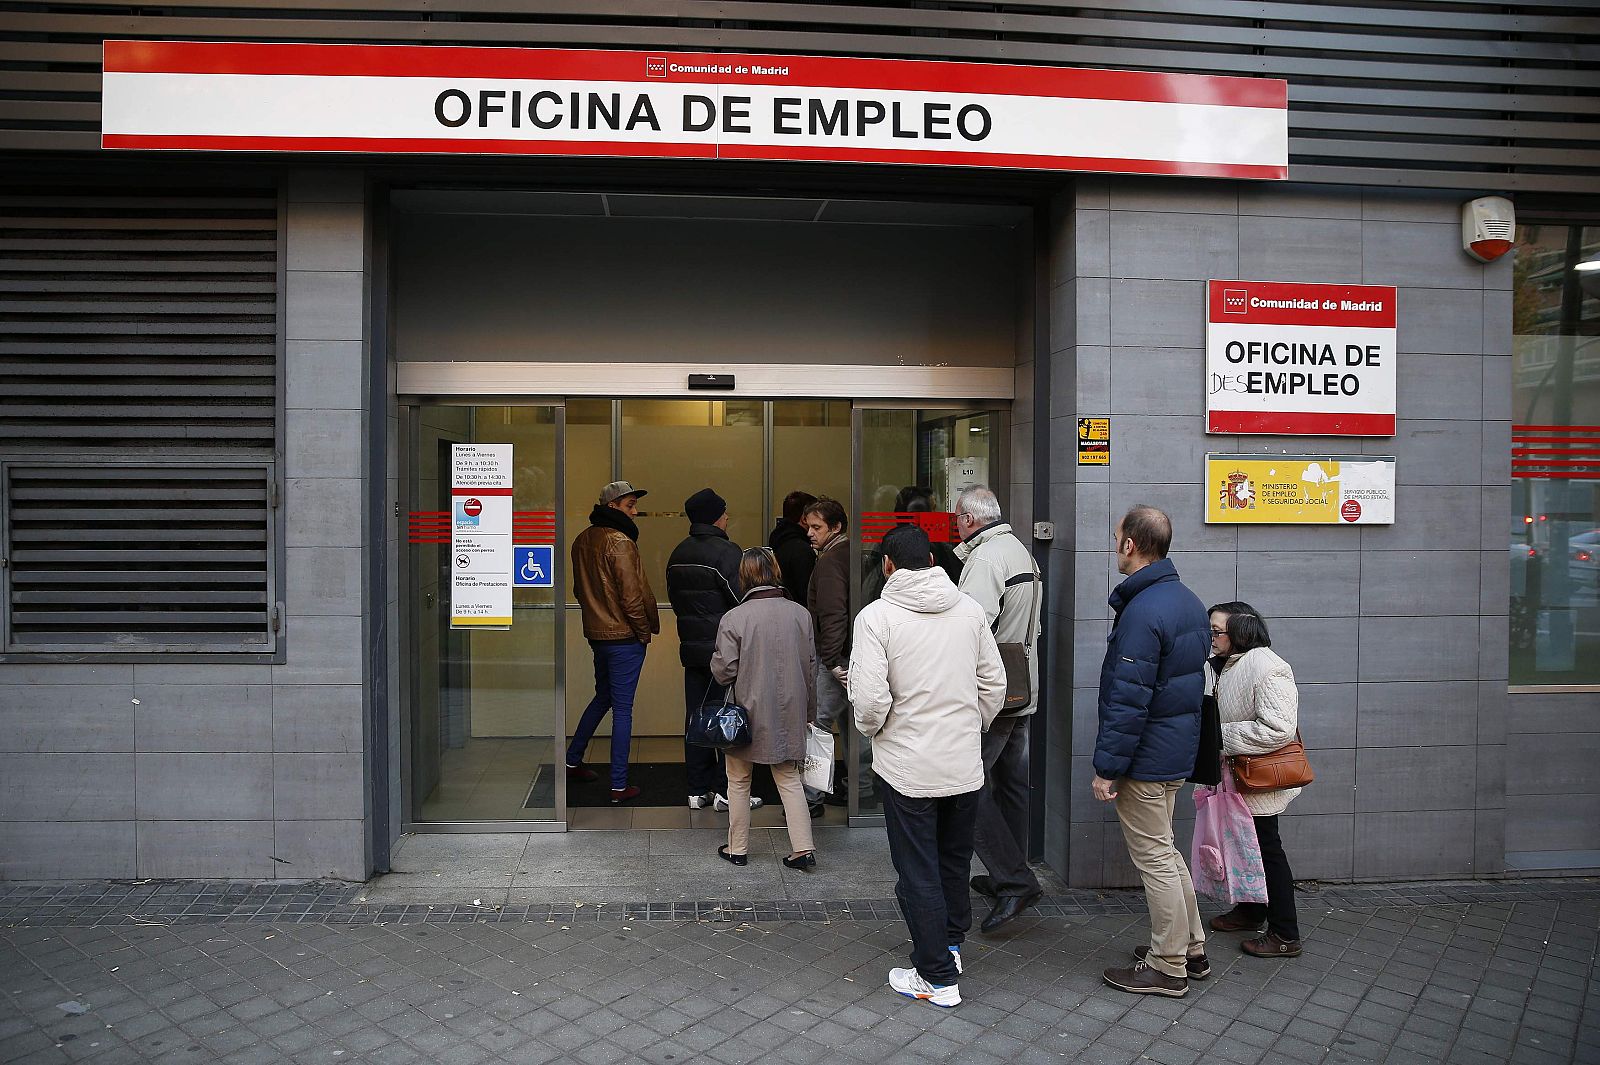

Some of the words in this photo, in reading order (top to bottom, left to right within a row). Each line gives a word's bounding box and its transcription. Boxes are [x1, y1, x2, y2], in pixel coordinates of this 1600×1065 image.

[669, 63, 732, 74] Comunidad
[735, 65, 748, 74] de
[751, 65, 789, 76] Madrid
[434, 88, 661, 131] OFICINA
[682, 95, 751, 134] DE
[773, 98, 992, 142] EMPLEO
[1250, 297, 1319, 310] Comunidad
[1322, 299, 1337, 310] de
[1340, 300, 1382, 312] Madrid
[1225, 340, 1337, 366] OFICINA
[1345, 344, 1381, 367] DE
